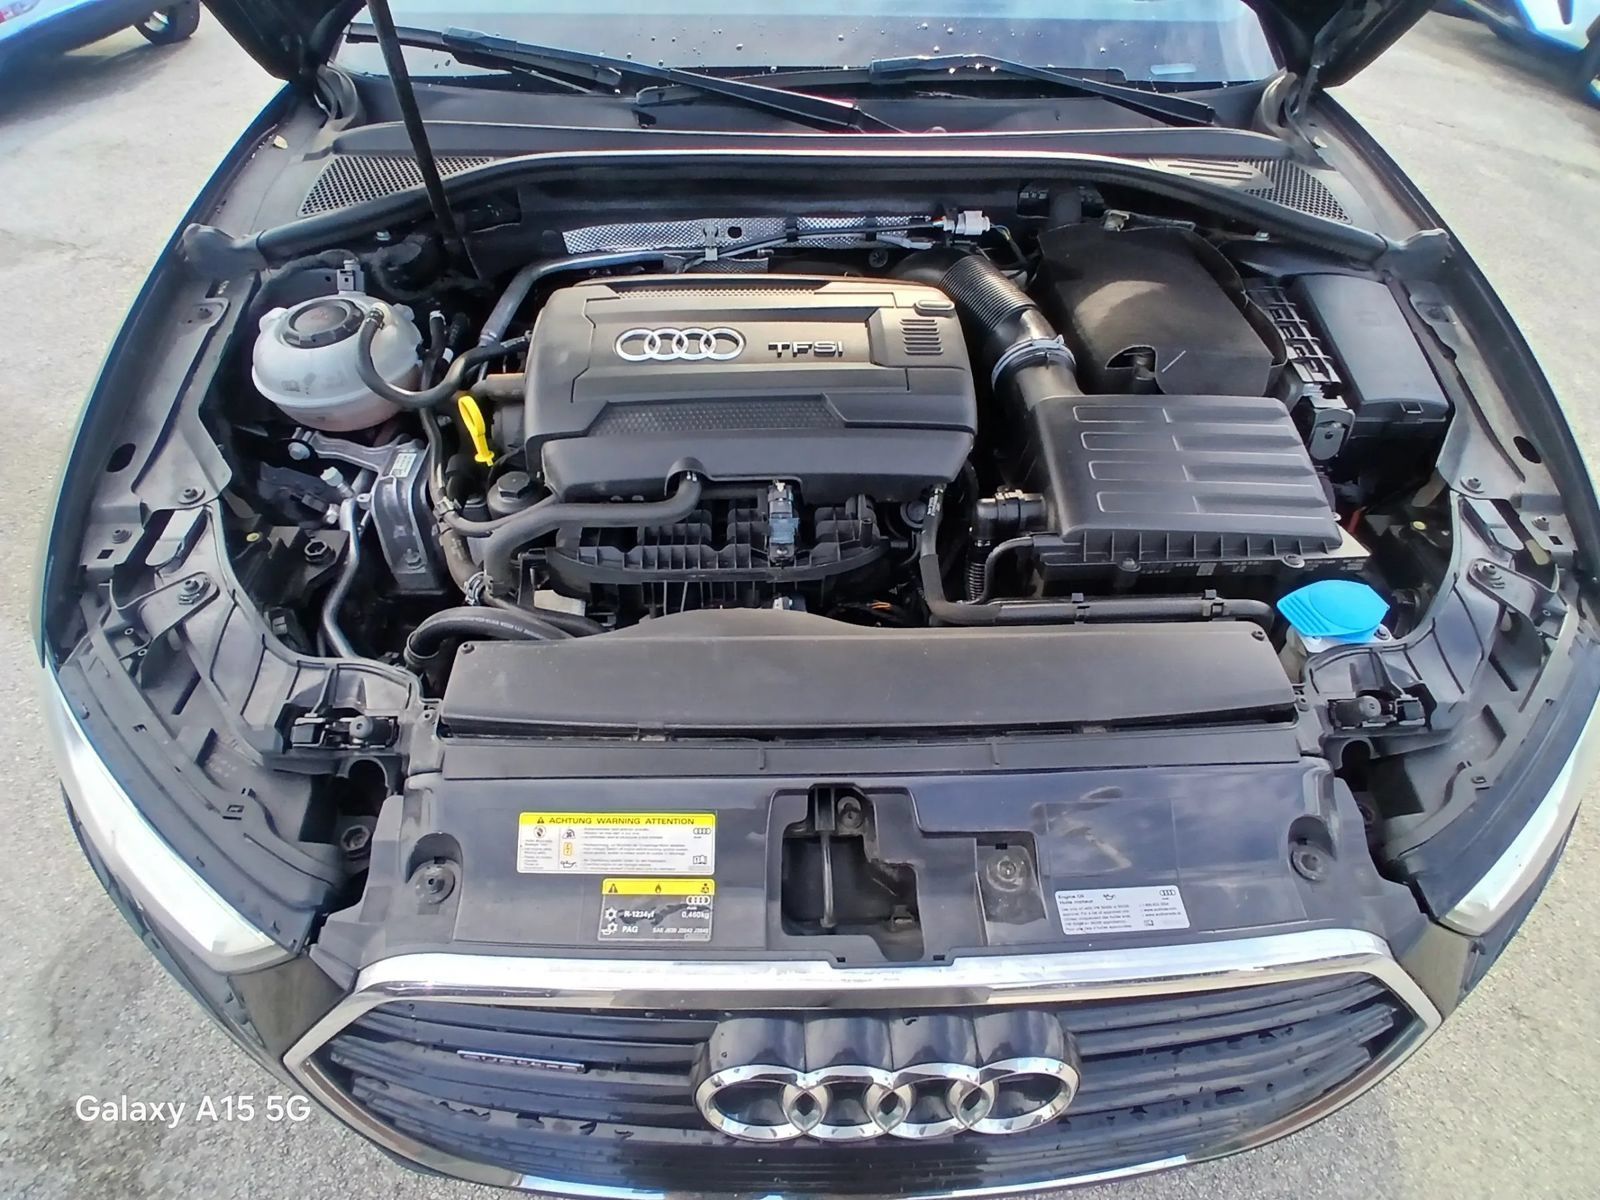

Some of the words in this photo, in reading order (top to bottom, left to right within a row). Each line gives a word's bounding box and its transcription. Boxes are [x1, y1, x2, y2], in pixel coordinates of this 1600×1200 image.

[768, 341, 843, 357] TFSI
[597, 817, 641, 825] WARNING
[645, 817, 695, 825] ATTENTION
[624, 910, 655, 919] R-1234yf
[622, 925, 638, 933] PAG
